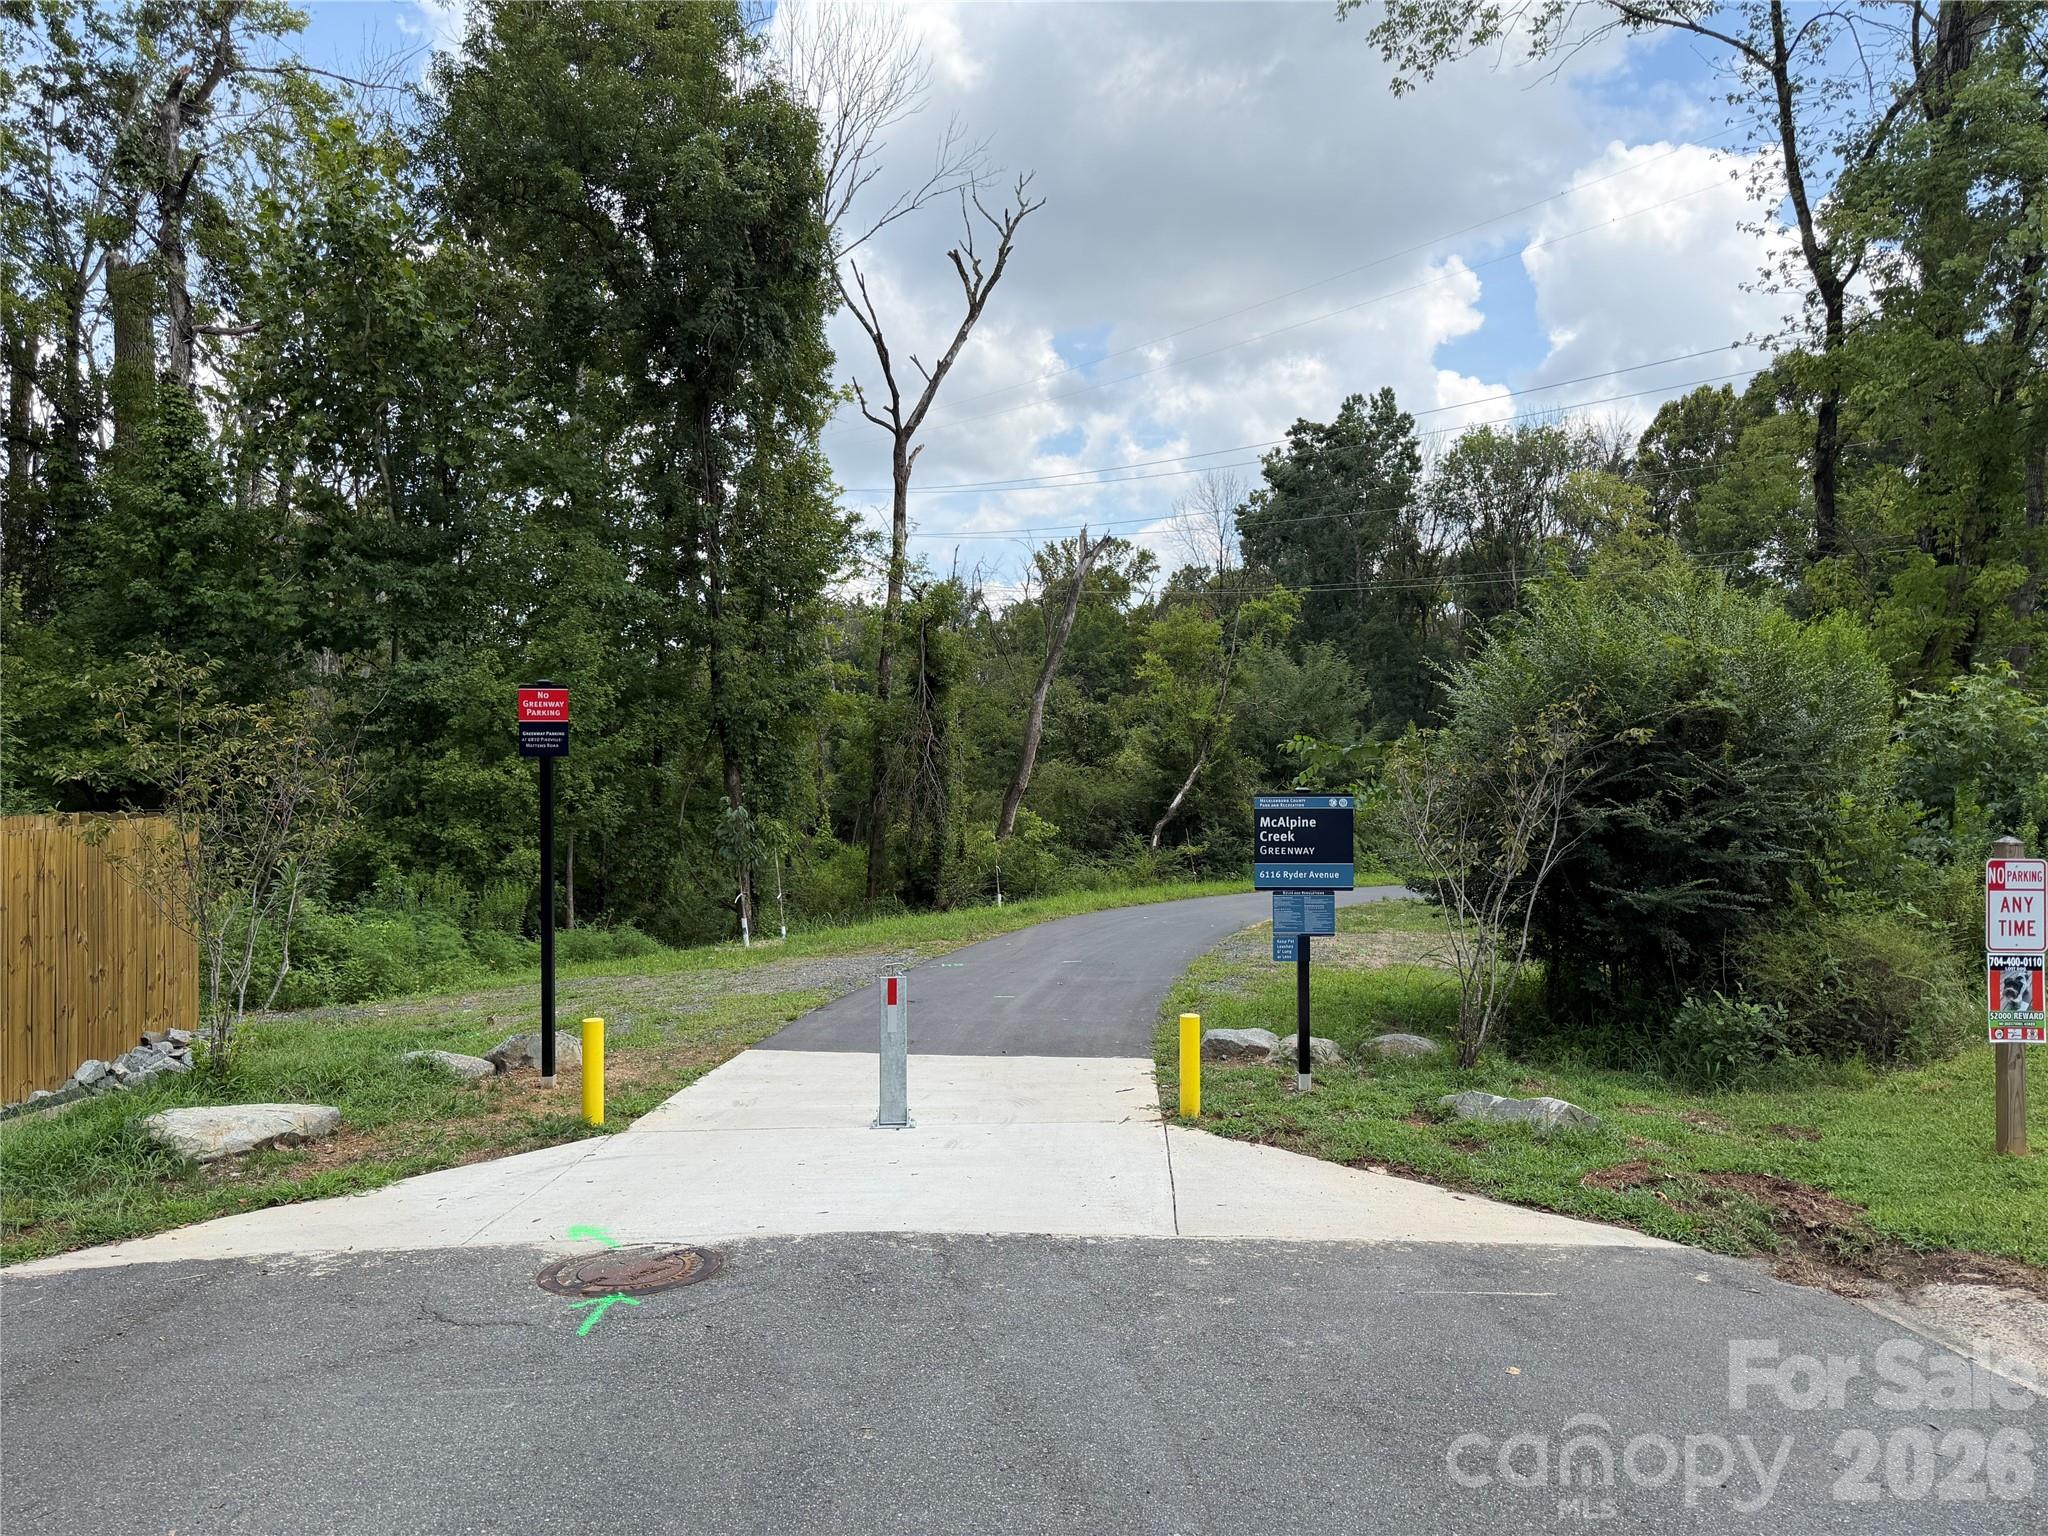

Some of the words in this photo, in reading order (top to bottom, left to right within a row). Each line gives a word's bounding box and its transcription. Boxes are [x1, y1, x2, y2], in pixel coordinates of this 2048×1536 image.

[522, 700, 565, 708] GREENWAY
[1260, 816, 1317, 830] McAlpine
[1260, 831, 1295, 842] Creek
[1260, 845, 1315, 855] GREENWAY
[1260, 870, 1281, 879] 6116
[1283, 870, 1306, 880] Ryder
[1309, 870, 1340, 879] Avenue
[1988, 867, 2005, 884] NO
[2007, 870, 2043, 882] PARKING
[2000, 896, 2034, 913] ANY
[1998, 920, 2036, 937] TIME
[1990, 957, 2042, 967] 704-400-0110
[1990, 1012, 2011, 1020] $2000
[2013, 1012, 2044, 1020] REWARD
